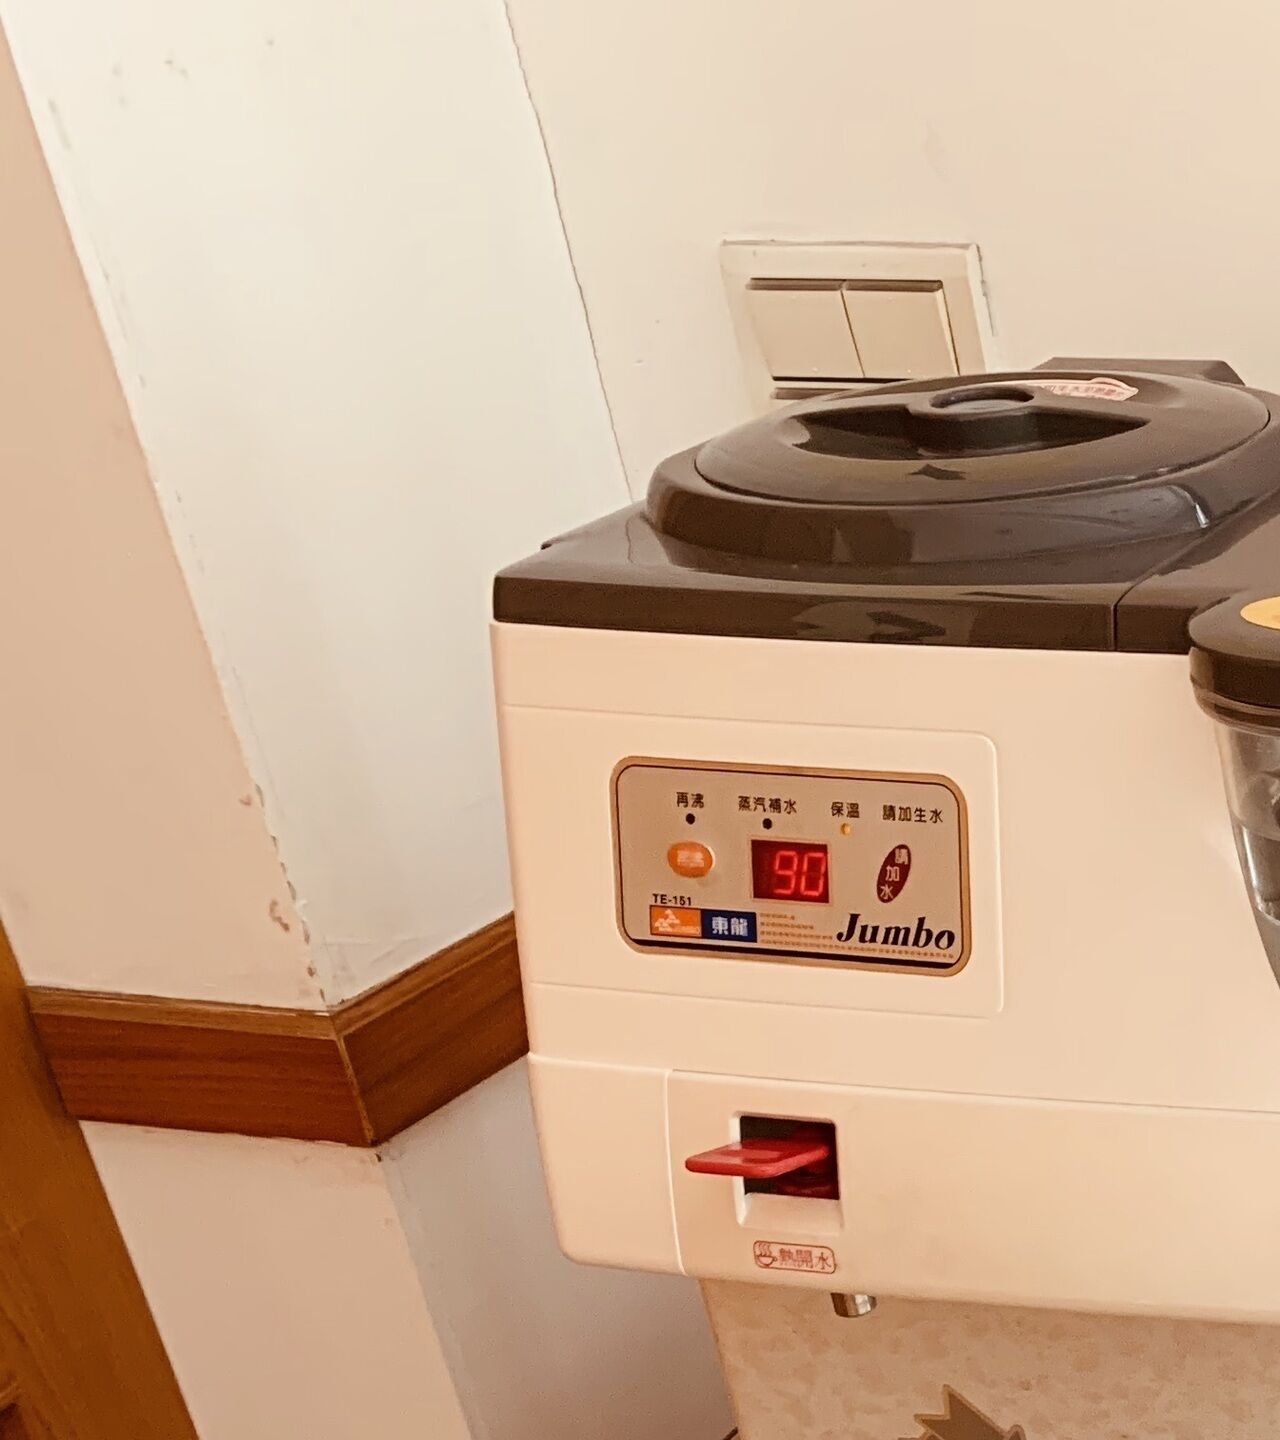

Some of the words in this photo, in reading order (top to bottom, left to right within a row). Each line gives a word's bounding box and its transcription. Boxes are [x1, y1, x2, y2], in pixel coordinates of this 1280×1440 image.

[882, 804, 944, 824] 請加生水
[773, 850, 826, 897] 90
[652, 893, 692, 907] TE-151
[711, 916, 749, 937] 東龍
[836, 912, 956, 951] Jumbo
